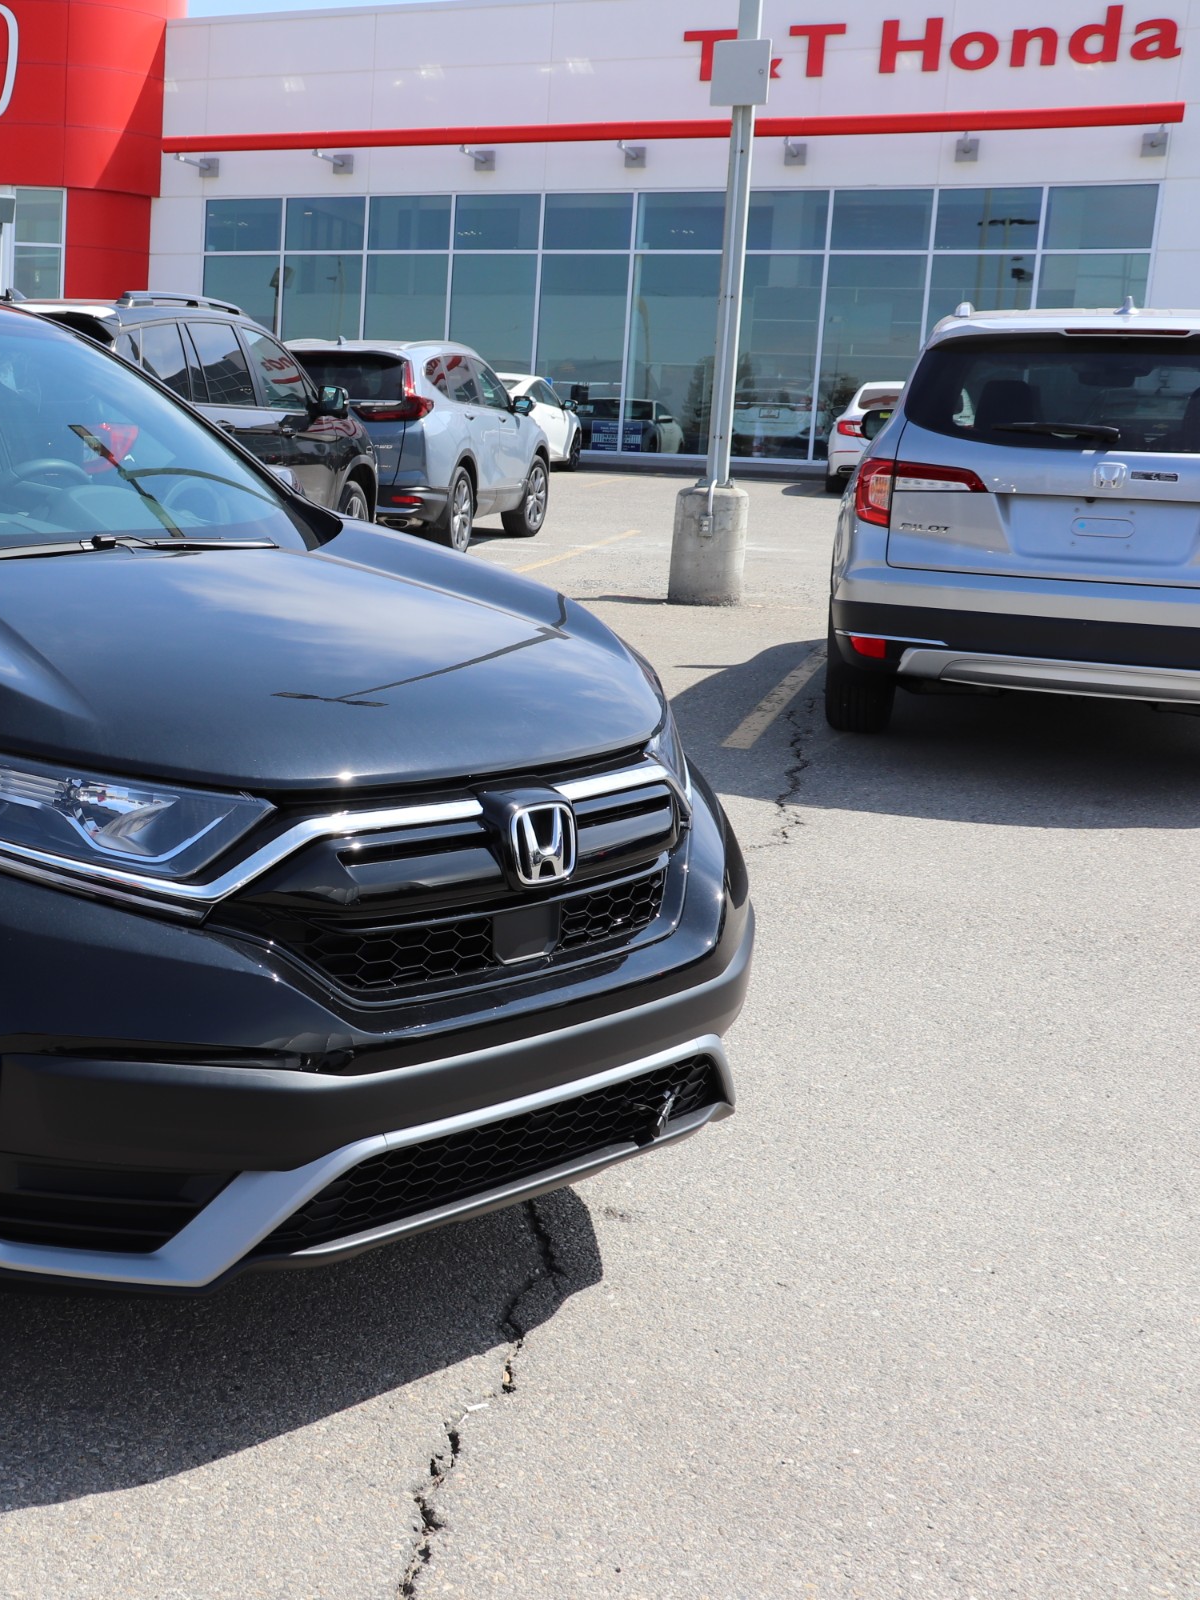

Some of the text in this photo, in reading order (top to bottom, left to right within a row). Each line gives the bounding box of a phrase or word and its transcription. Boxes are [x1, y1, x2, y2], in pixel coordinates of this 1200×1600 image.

[684, 4, 1182, 82] TT Honda
[899, 522, 951, 534] PILOT
